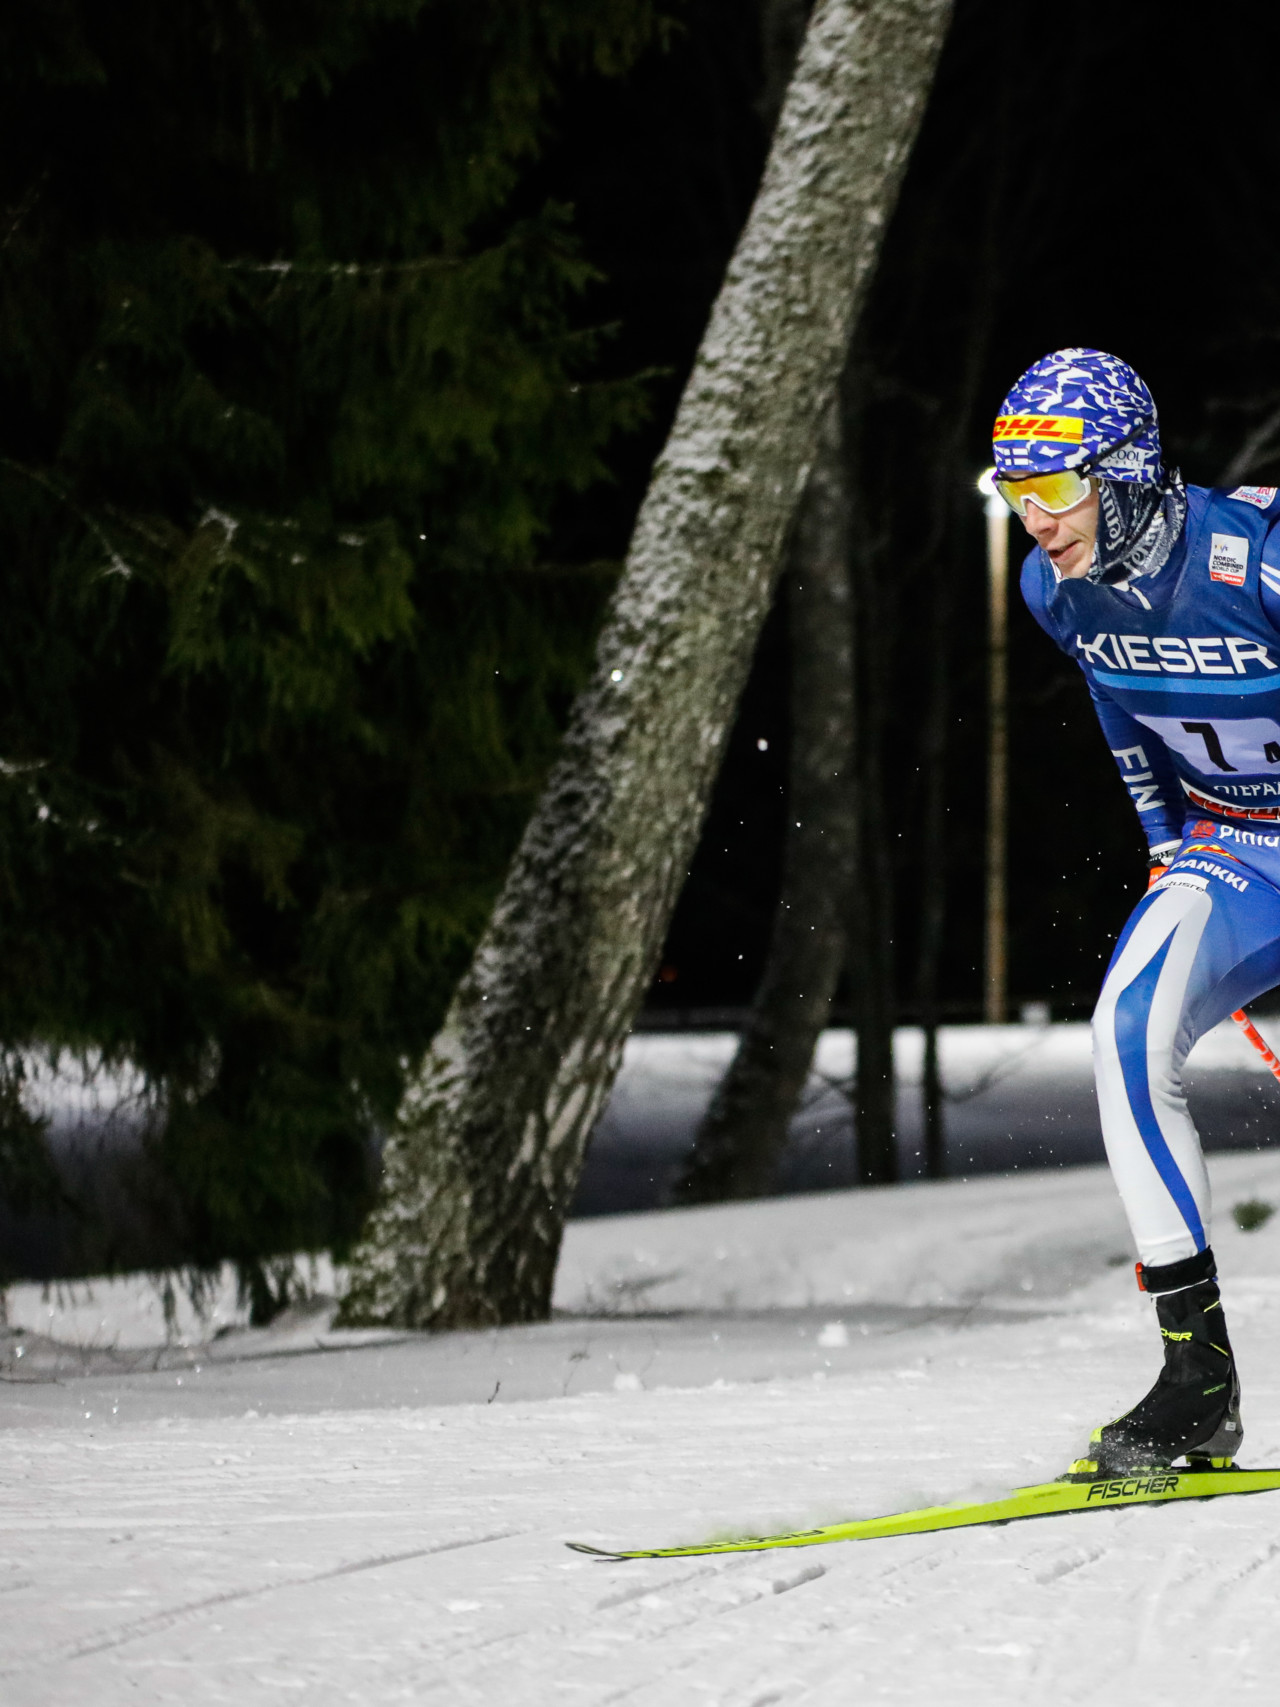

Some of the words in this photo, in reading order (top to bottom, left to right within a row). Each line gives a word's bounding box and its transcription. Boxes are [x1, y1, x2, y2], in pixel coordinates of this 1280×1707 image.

[993, 419, 1063, 437] DHL
[1076, 633, 1278, 674] KIESER
[1111, 745, 1166, 812] FIN
[1169, 859, 1250, 893] PANKKI
[1086, 1475, 1179, 1502] FISCHER
